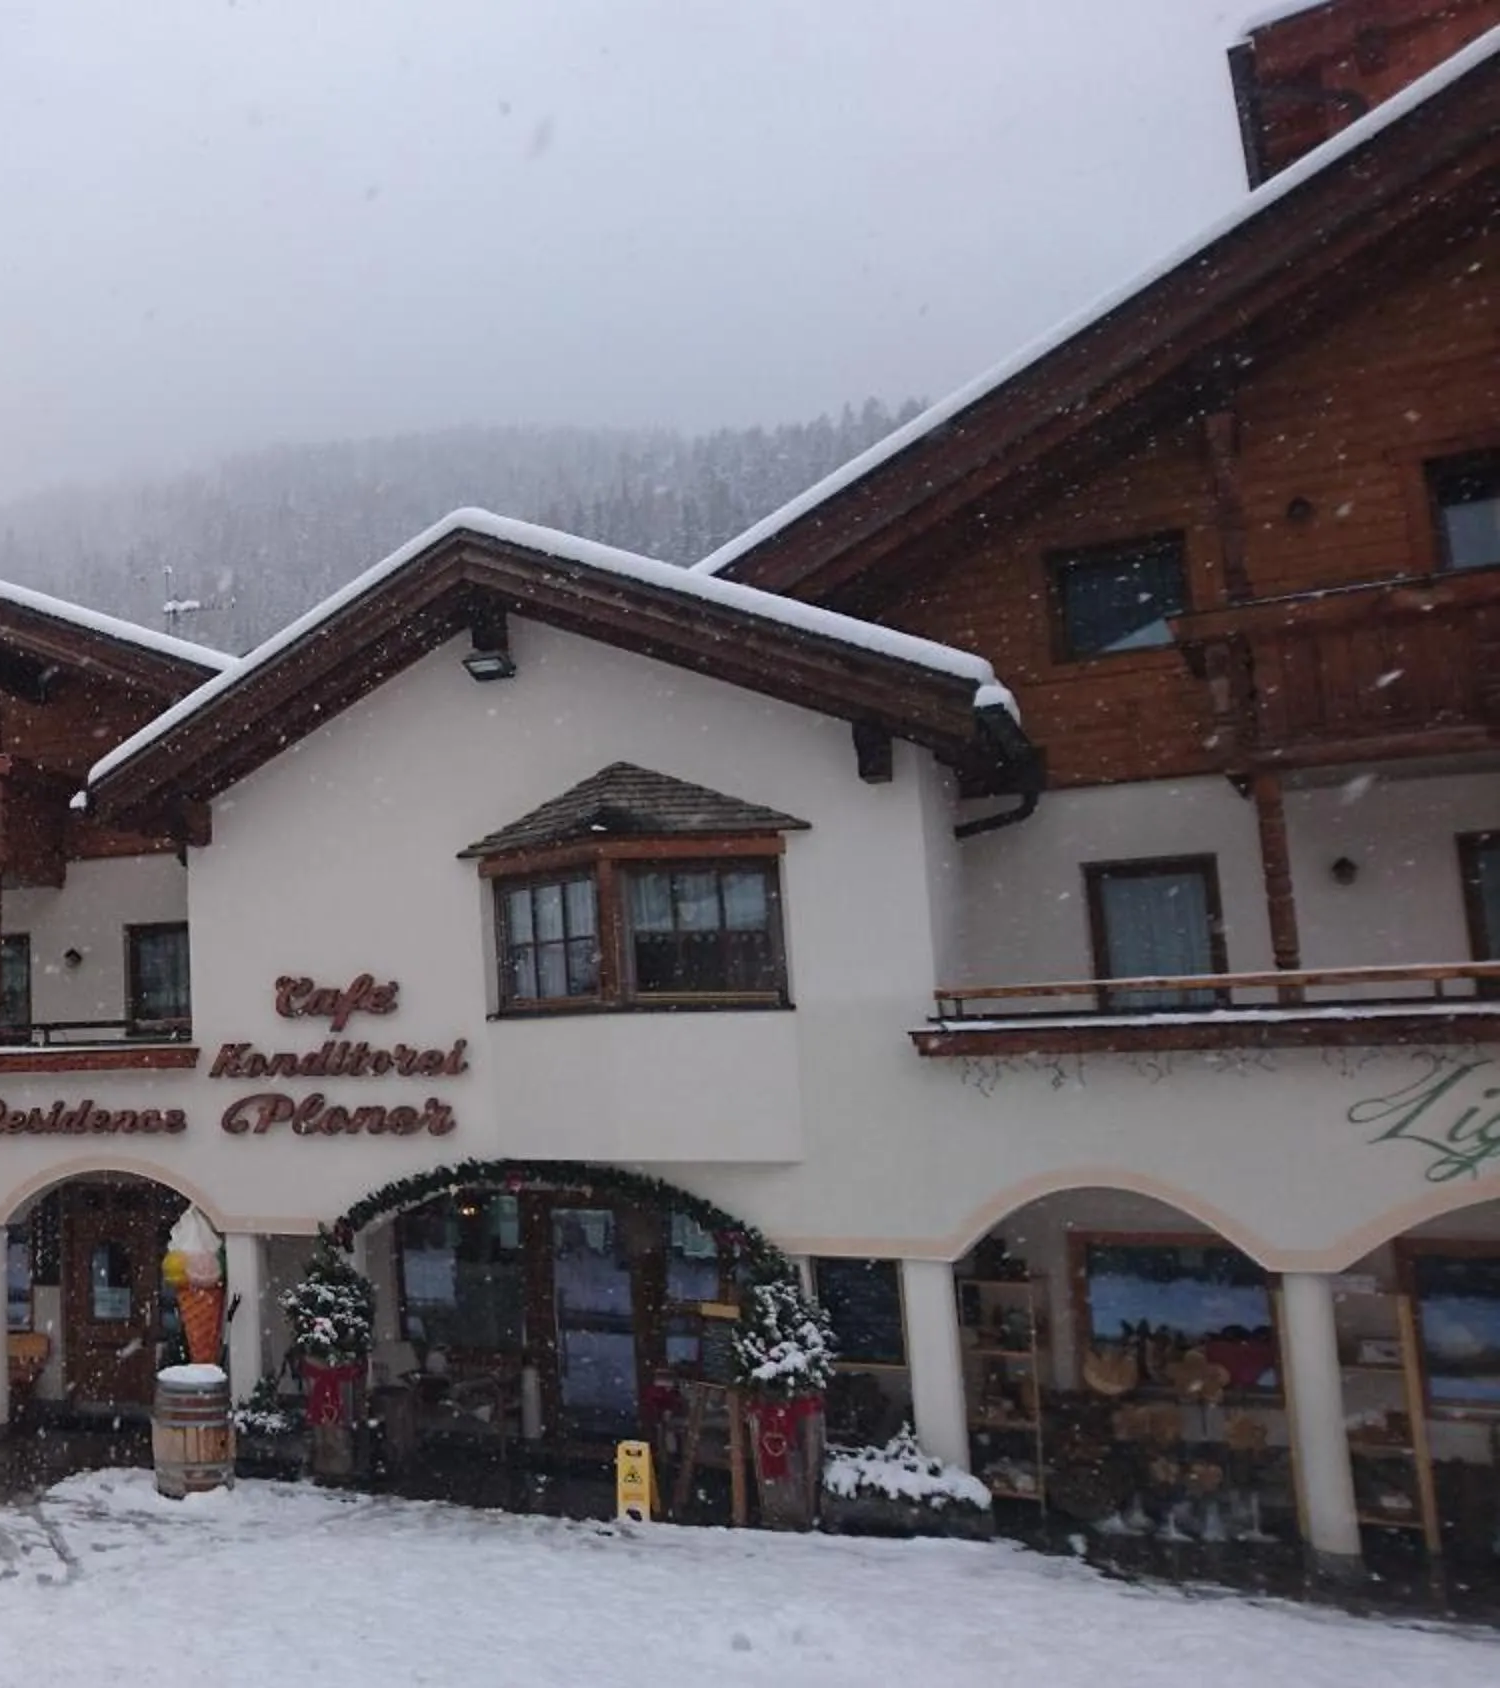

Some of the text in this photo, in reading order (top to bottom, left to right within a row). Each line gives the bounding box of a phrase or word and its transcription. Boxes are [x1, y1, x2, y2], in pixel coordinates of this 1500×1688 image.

[276, 973, 400, 1032] Café
[209, 1038, 469, 1079] Konditorei
[221, 1092, 457, 1136] Ploner
